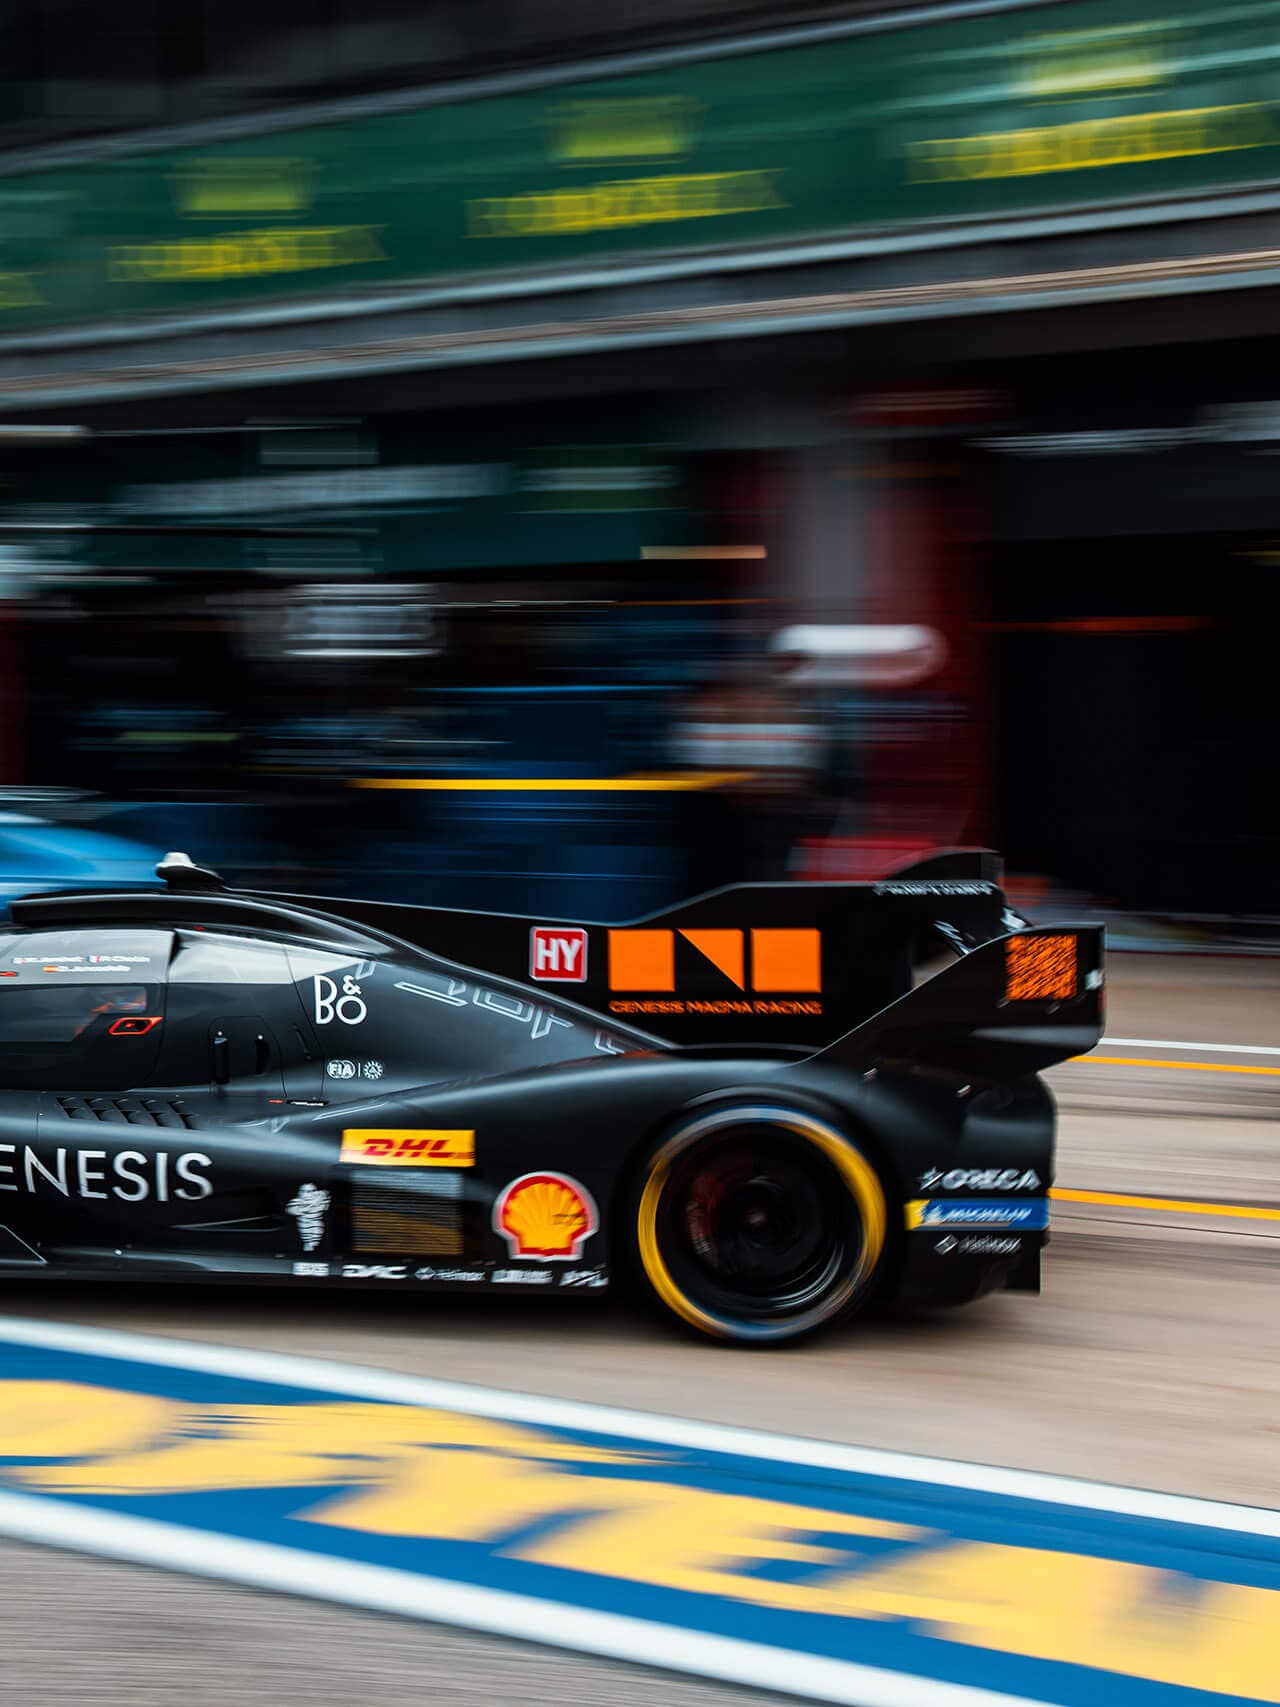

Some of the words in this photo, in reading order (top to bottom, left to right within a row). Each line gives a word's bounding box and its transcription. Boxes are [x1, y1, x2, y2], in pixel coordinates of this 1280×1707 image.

[535, 938, 583, 972] HY
[608, 1000, 685, 1014] GENESIS
[686, 1001, 753, 1015] MAGMA
[753, 1001, 822, 1015] RACING
[328, 1061, 354, 1077] FIA
[361, 1138, 458, 1158] DHL
